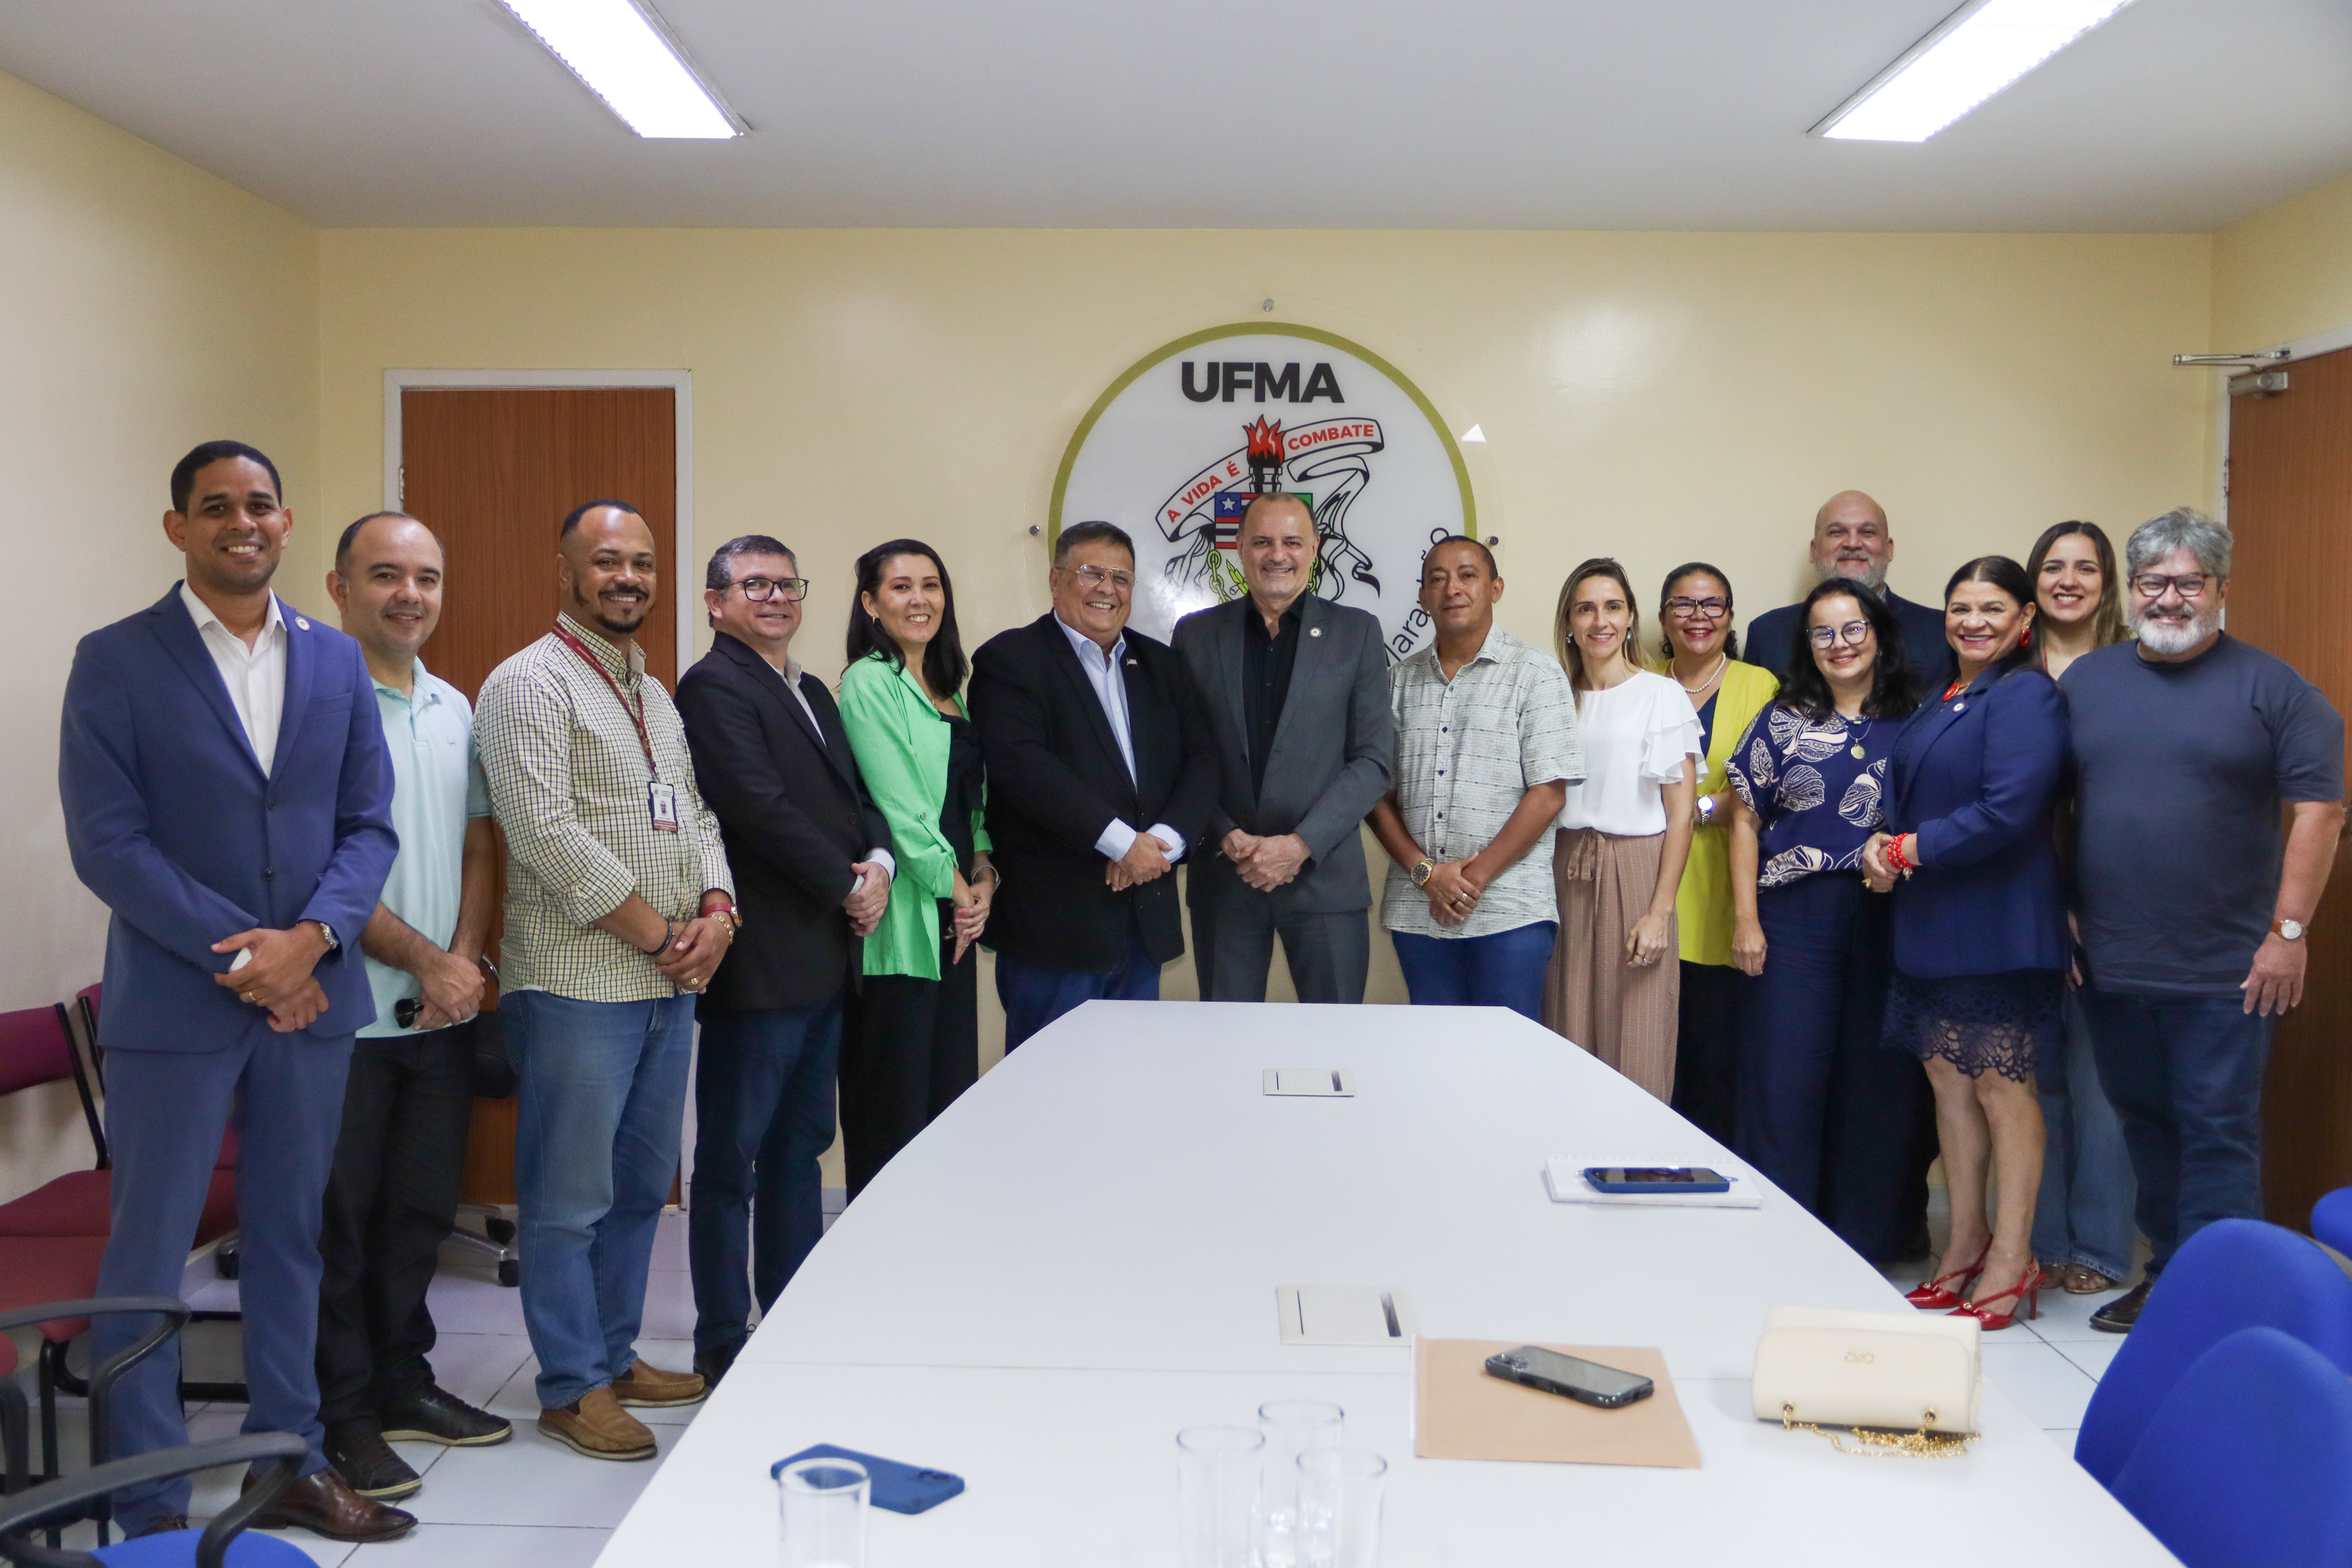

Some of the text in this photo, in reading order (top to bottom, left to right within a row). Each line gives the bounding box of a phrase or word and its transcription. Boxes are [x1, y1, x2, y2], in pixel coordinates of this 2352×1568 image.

[1182, 362, 1345, 403] UFMA
[1167, 425, 1374, 523] A VIDA É COMBATE
